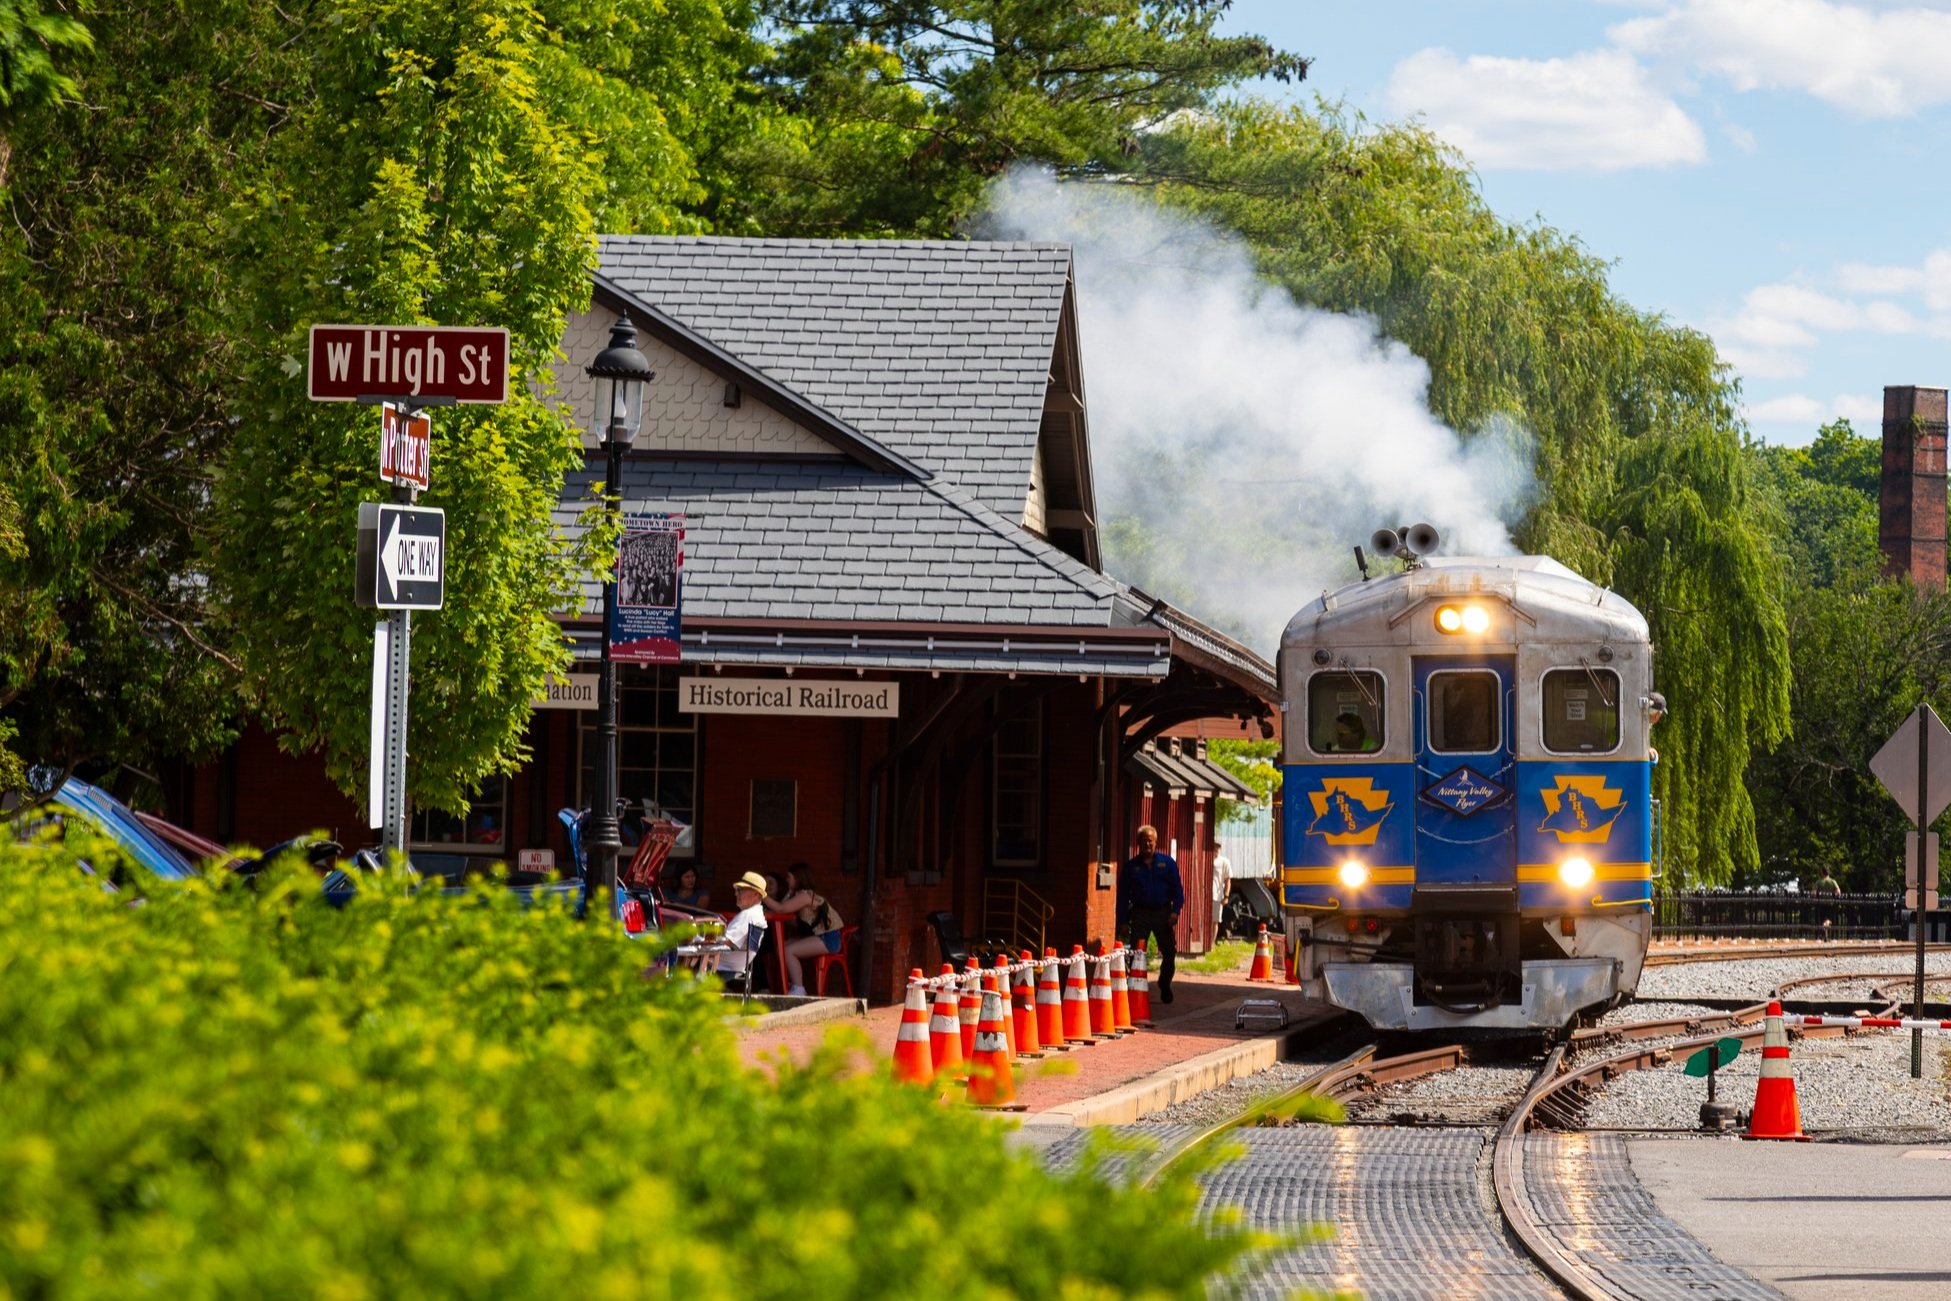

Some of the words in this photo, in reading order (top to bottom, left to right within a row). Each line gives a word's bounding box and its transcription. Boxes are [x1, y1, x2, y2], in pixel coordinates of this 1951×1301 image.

[327, 341, 352, 382] W
[363, 330, 446, 396] High
[458, 344, 492, 385] St
[389, 416, 419, 476] Potter
[419, 438, 428, 479] St
[662, 520, 683, 528] HERO
[397, 539, 416, 576] ONE
[418, 541, 437, 577] WAY
[689, 684, 793, 707] Historical
[799, 687, 889, 710] Railroad
[1437, 787, 1468, 798] Nittany
[1469, 786, 1494, 798] Valley
[532, 853, 542, 863] NO
